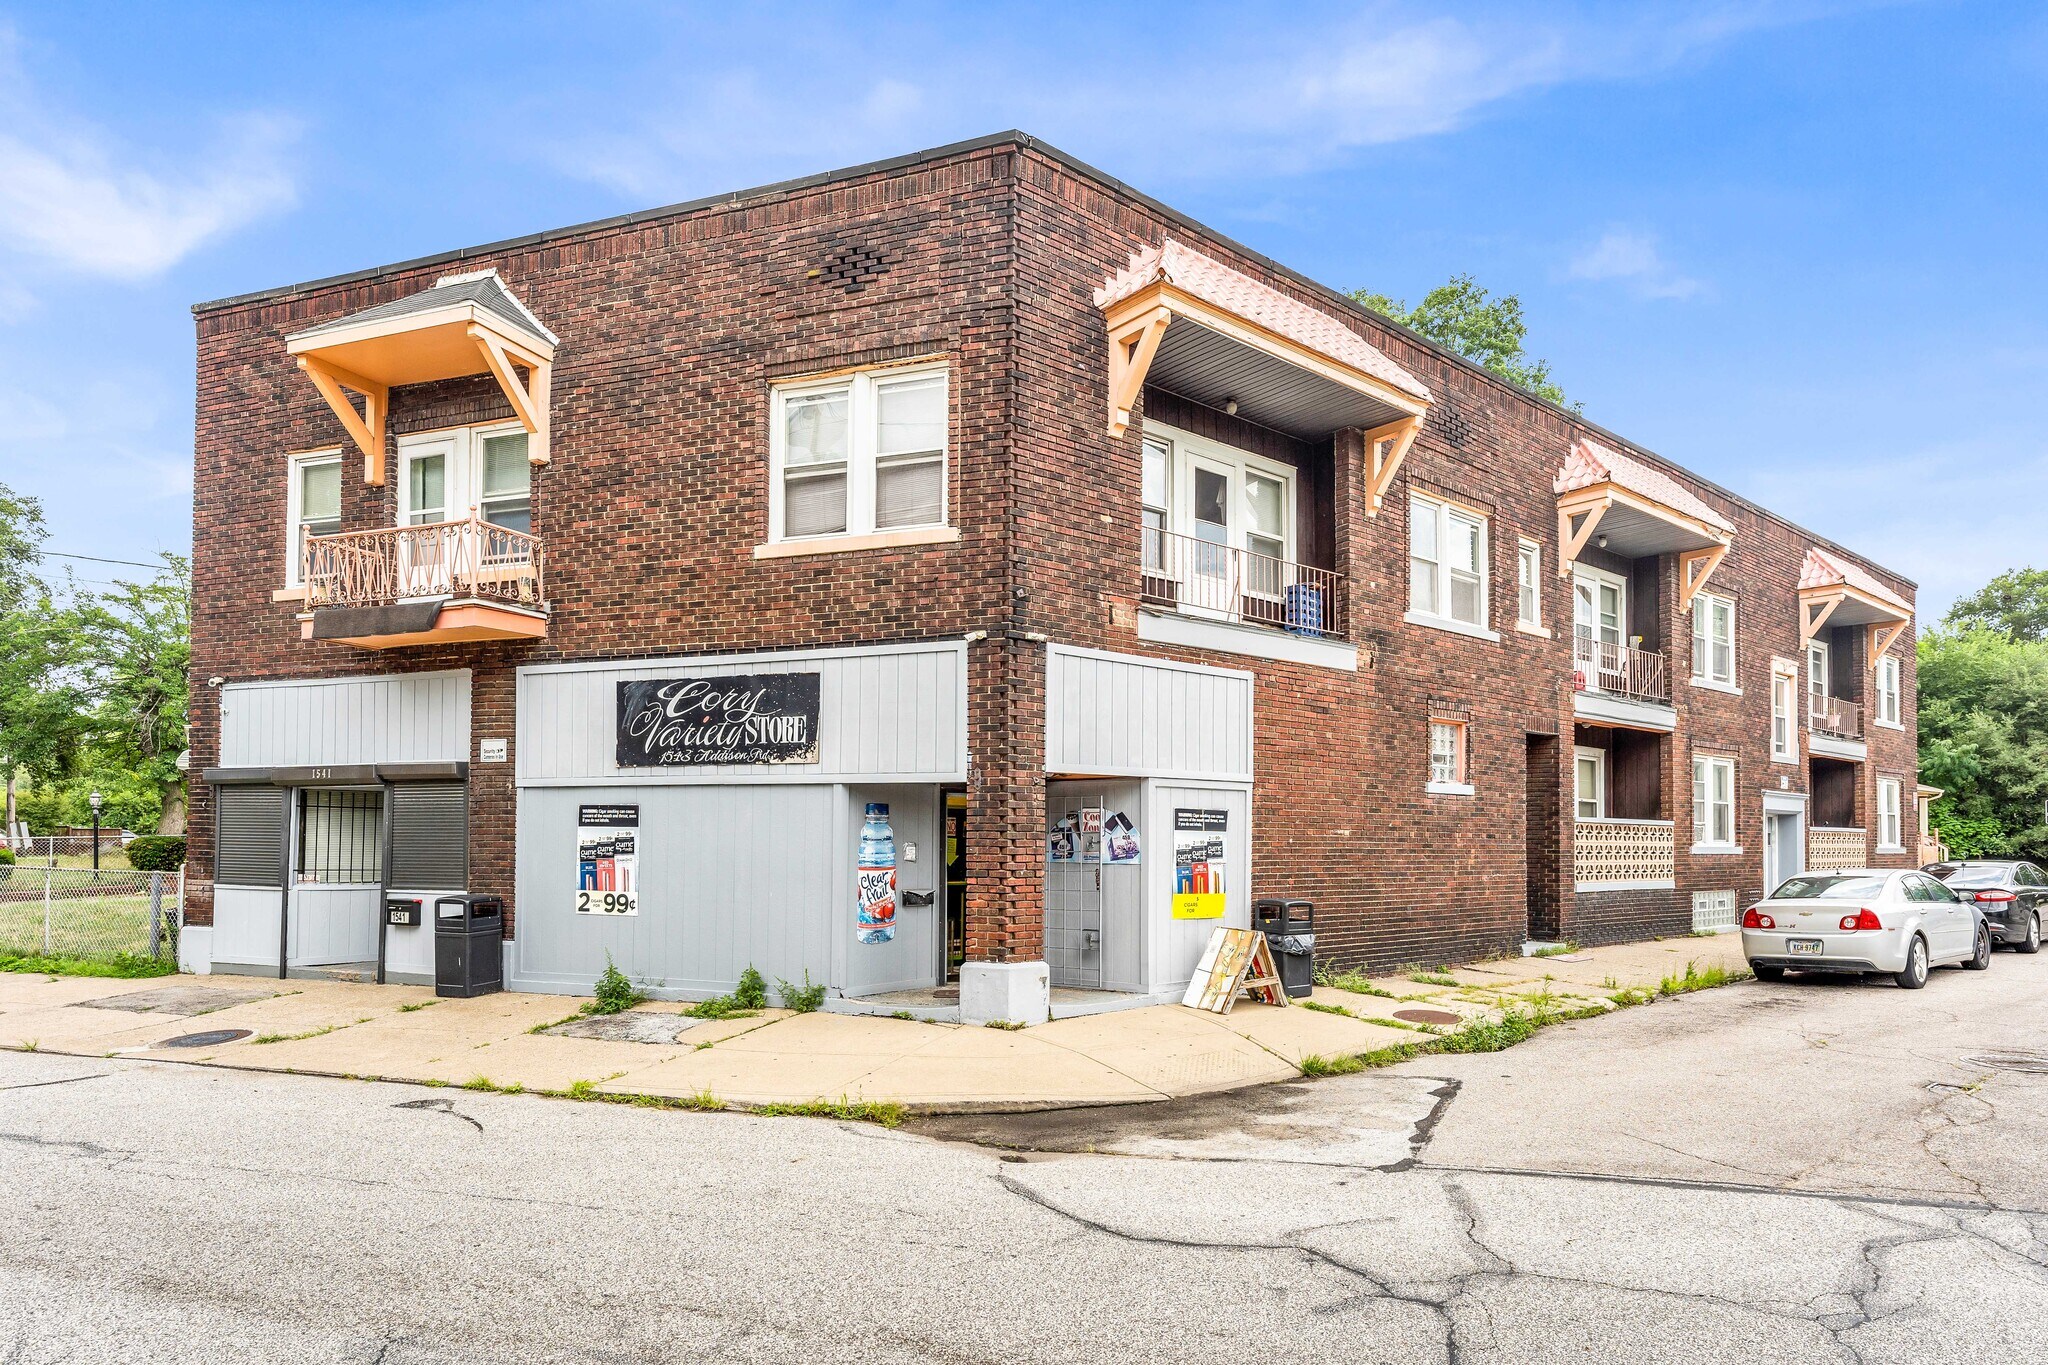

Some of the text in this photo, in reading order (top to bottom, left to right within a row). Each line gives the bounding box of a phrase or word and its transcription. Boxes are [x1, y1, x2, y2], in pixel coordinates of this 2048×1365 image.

[657, 681, 782, 723] Cory
[630, 701, 807, 754] Variety STORE
[694, 748, 750, 762] Addison
[312, 768, 332, 779] 1541
[1083, 822, 1100, 831] Zon
[866, 880, 889, 905] fruit
[578, 892, 590, 912] 2
[604, 893, 636, 914] 99¢
[392, 912, 405, 922] 1541
